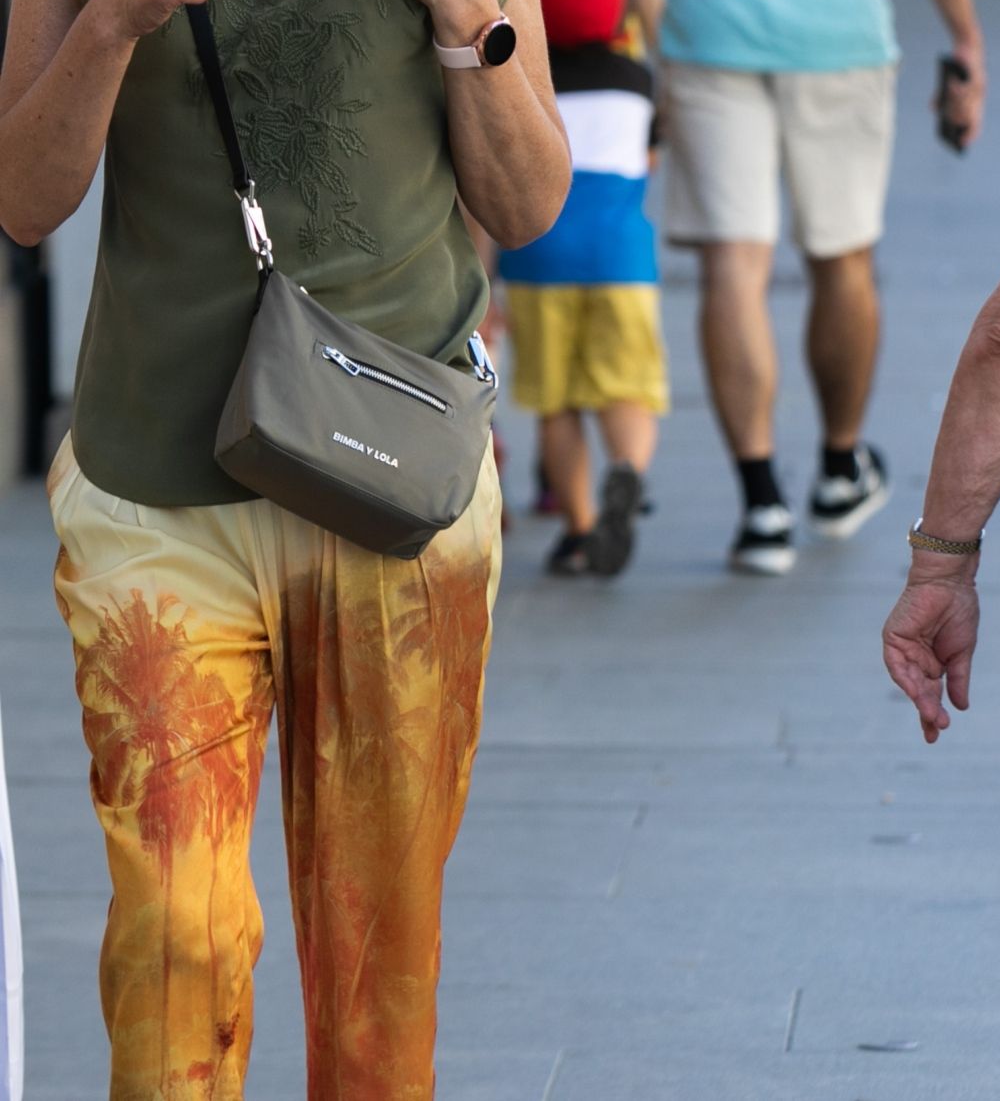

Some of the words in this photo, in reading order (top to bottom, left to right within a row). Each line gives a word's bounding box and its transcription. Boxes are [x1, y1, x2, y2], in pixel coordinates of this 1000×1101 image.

[333, 431, 364, 452] BIMBA
[366, 446, 373, 455] Y
[374, 450, 398, 468] LOLA
